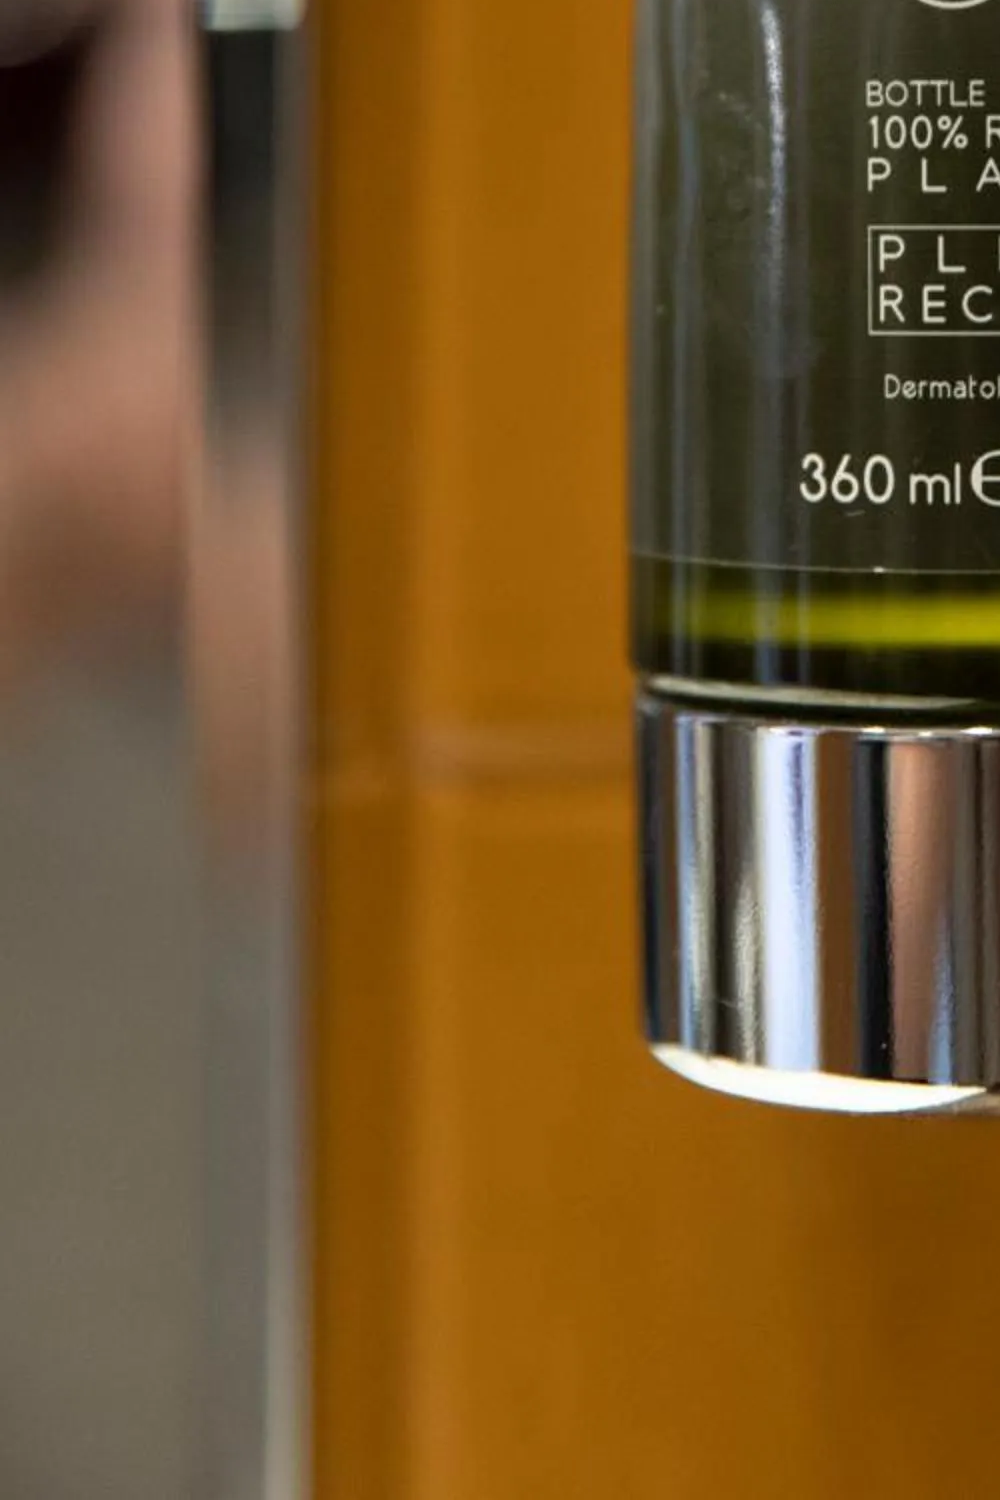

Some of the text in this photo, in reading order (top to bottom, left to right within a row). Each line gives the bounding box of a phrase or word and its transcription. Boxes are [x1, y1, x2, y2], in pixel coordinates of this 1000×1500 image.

[866, 79, 985, 106] BOTTLE
[869, 115, 968, 150] 100%
[800, 453, 895, 504] 360
[909, 462, 961, 504] ml
